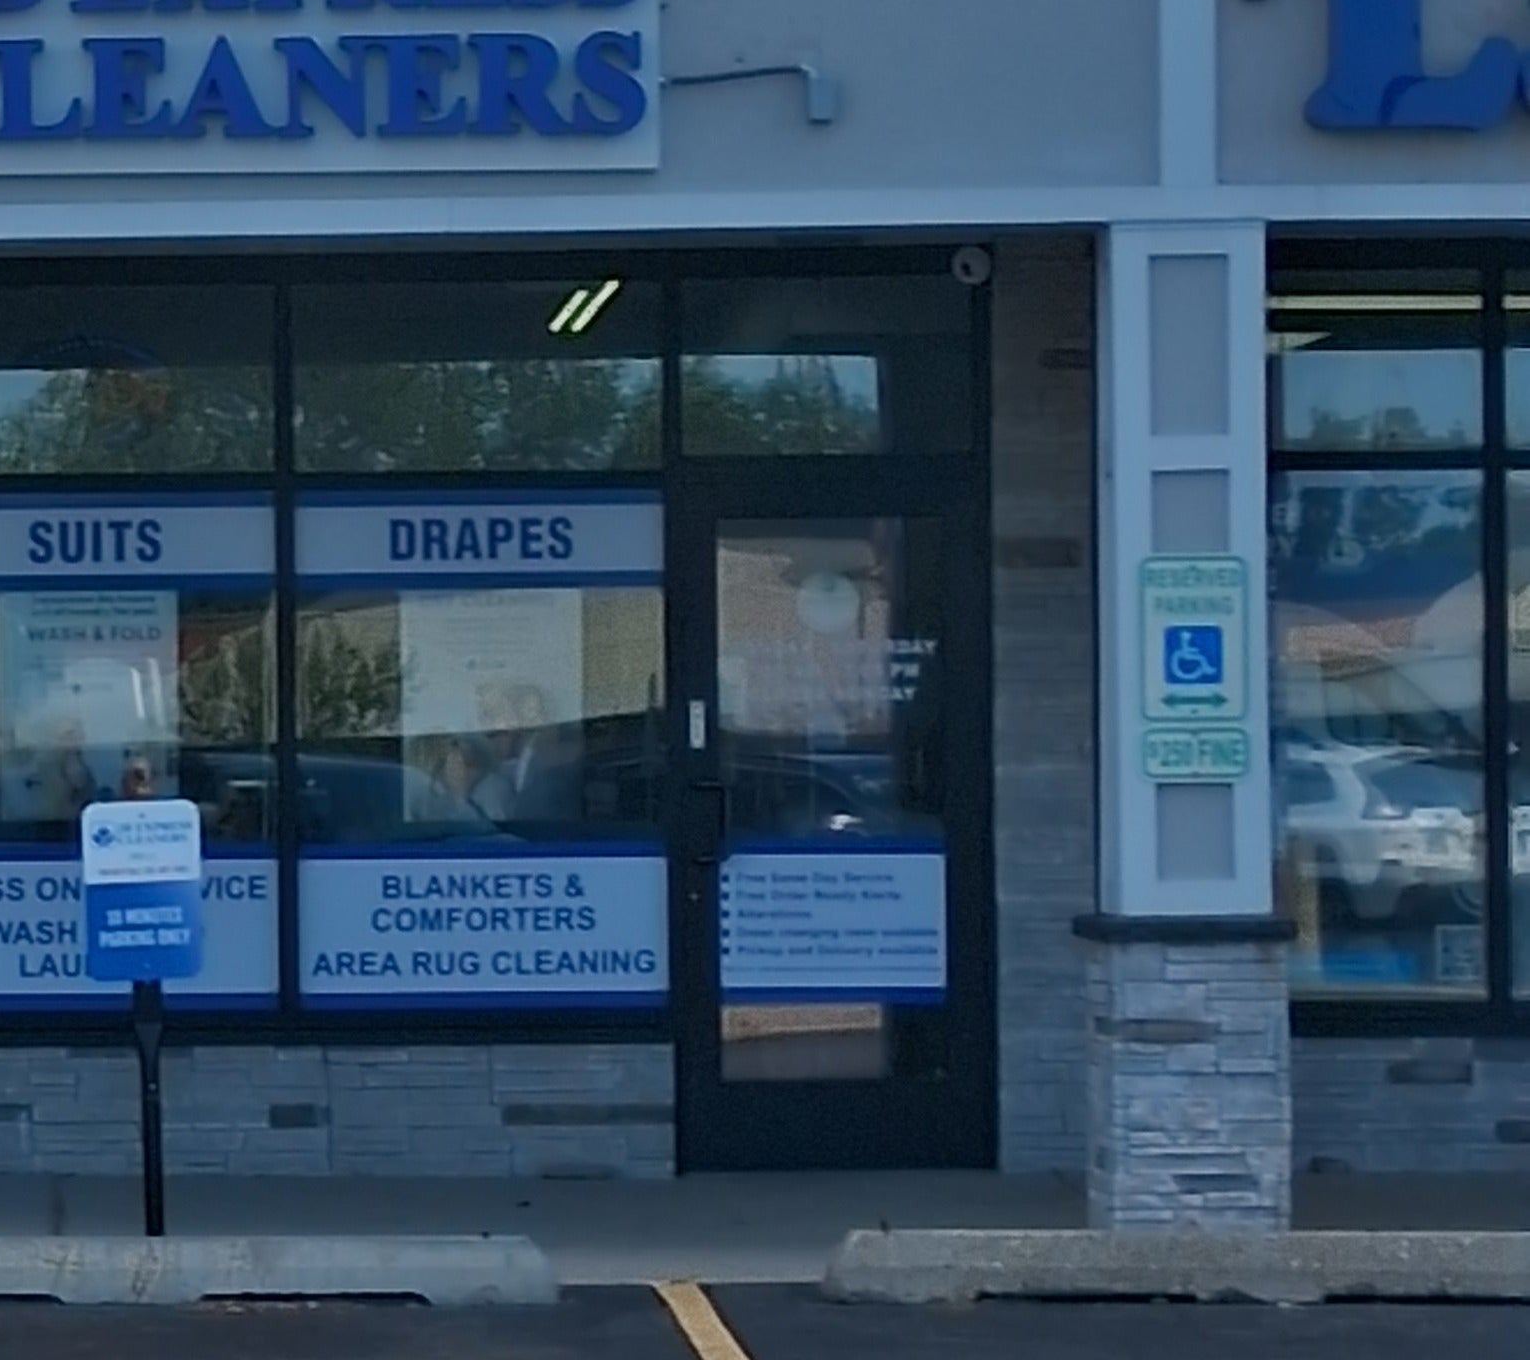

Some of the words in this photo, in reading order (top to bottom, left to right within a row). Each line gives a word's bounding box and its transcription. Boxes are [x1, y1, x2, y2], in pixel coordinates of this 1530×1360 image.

[27, 520, 163, 565] SUITS
[389, 517, 575, 562] DRAPES
[1143, 567, 1244, 588] RESERVED
[1153, 596, 1235, 614] PARKING
[27, 626, 86, 642] WASH
[110, 626, 162, 641] FOLD
[1197, 739, 1246, 767] FINE
[35, 877, 83, 902] ON
[381, 874, 550, 900] BLANKETS
[564, 874, 586, 899] &
[371, 906, 597, 933] COMFORTERS
[312, 950, 402, 977] AREA
[412, 949, 481, 976] RUG
[493, 949, 657, 976] CLEANING
